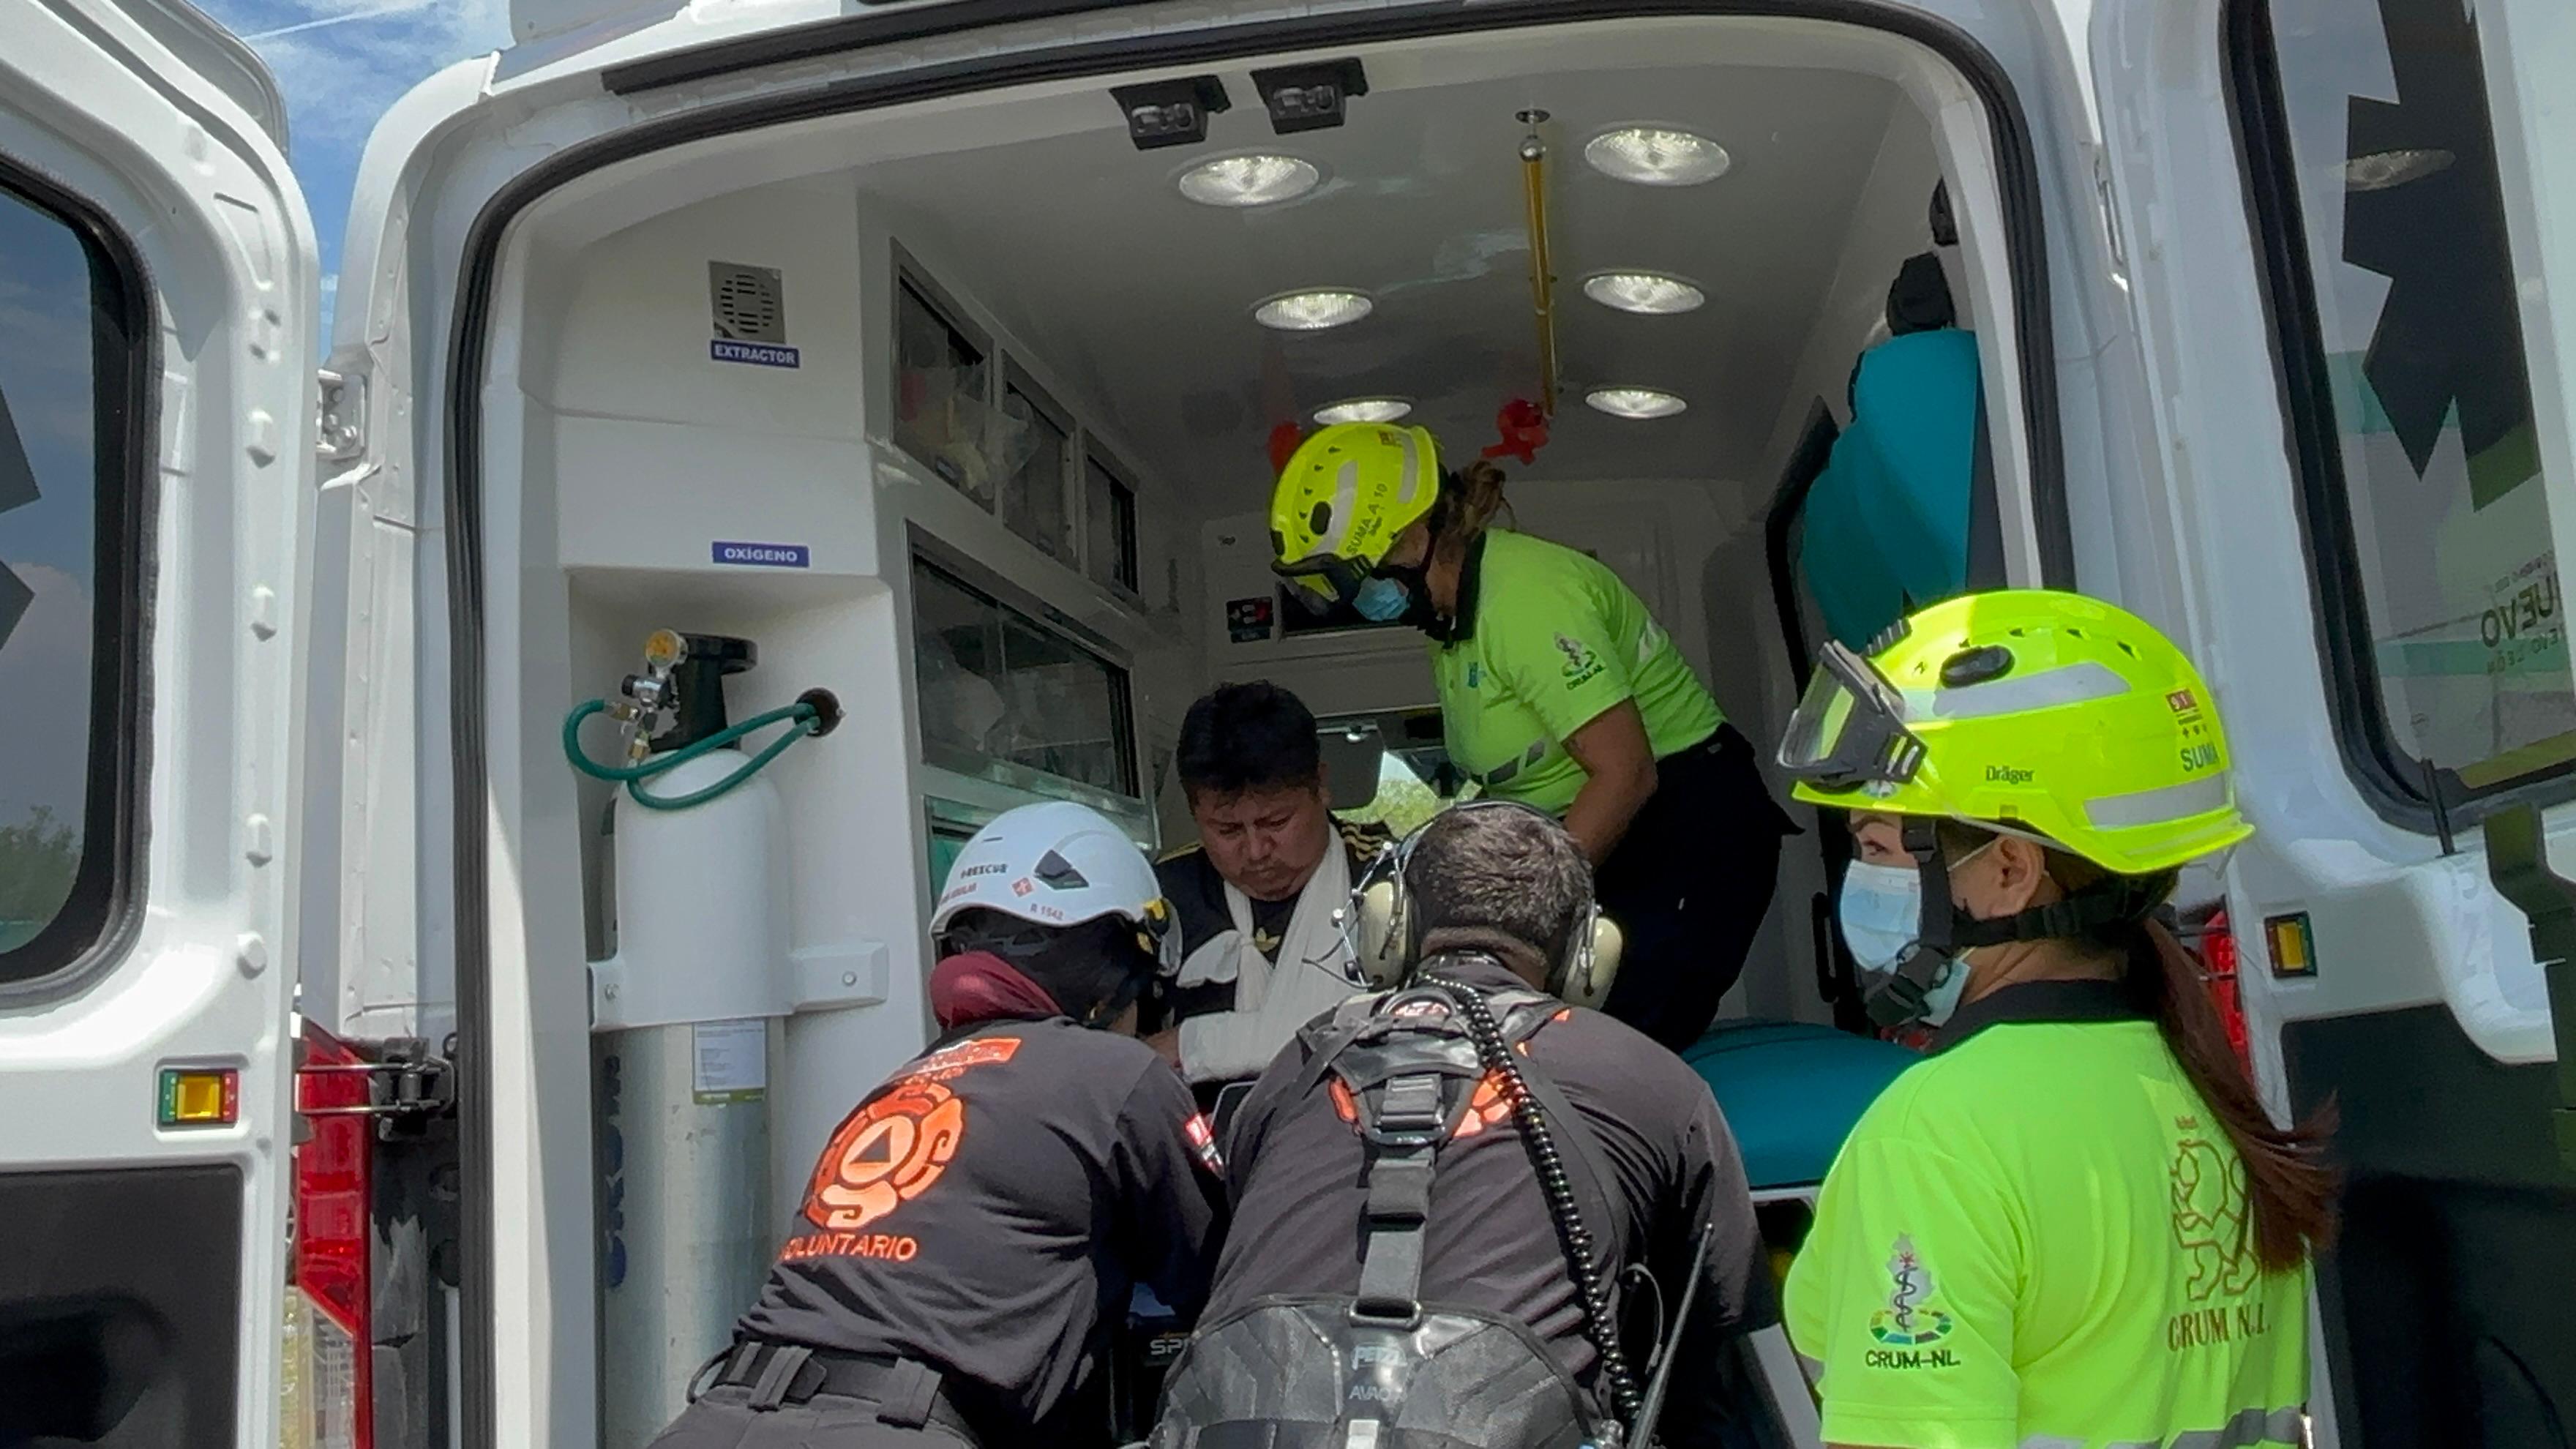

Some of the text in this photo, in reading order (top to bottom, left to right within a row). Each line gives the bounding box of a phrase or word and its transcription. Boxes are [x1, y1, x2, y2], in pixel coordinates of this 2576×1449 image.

[714, 343, 795, 364] EXTRACTOR
[724, 546, 798, 562] OXÍGENO
[1985, 765, 2035, 785] Dräger
[2168, 1306, 2230, 1352] CRUM
[1865, 1349, 1961, 1370] CRUM-NL
